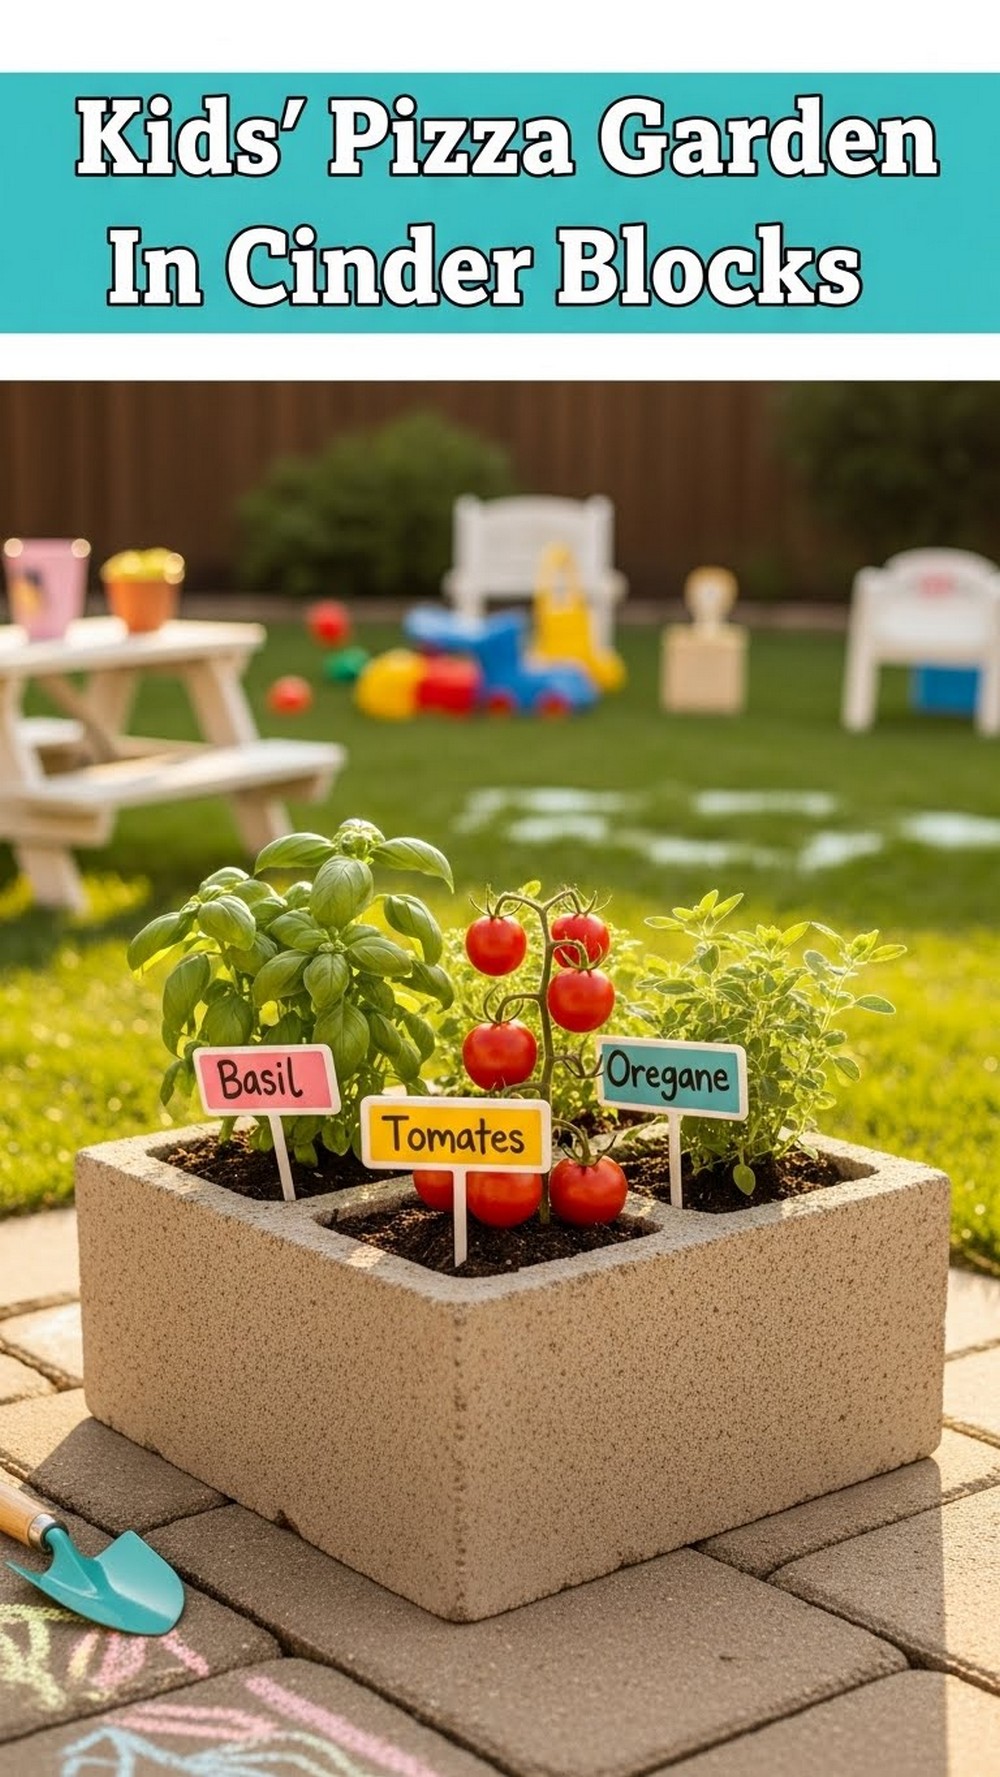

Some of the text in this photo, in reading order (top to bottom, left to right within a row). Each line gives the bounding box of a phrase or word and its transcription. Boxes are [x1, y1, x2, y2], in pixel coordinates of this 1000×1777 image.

[216, 1056, 303, 1100] Basil
[607, 1049, 730, 1102] Oregane
[381, 1114, 525, 1155] Tomates
